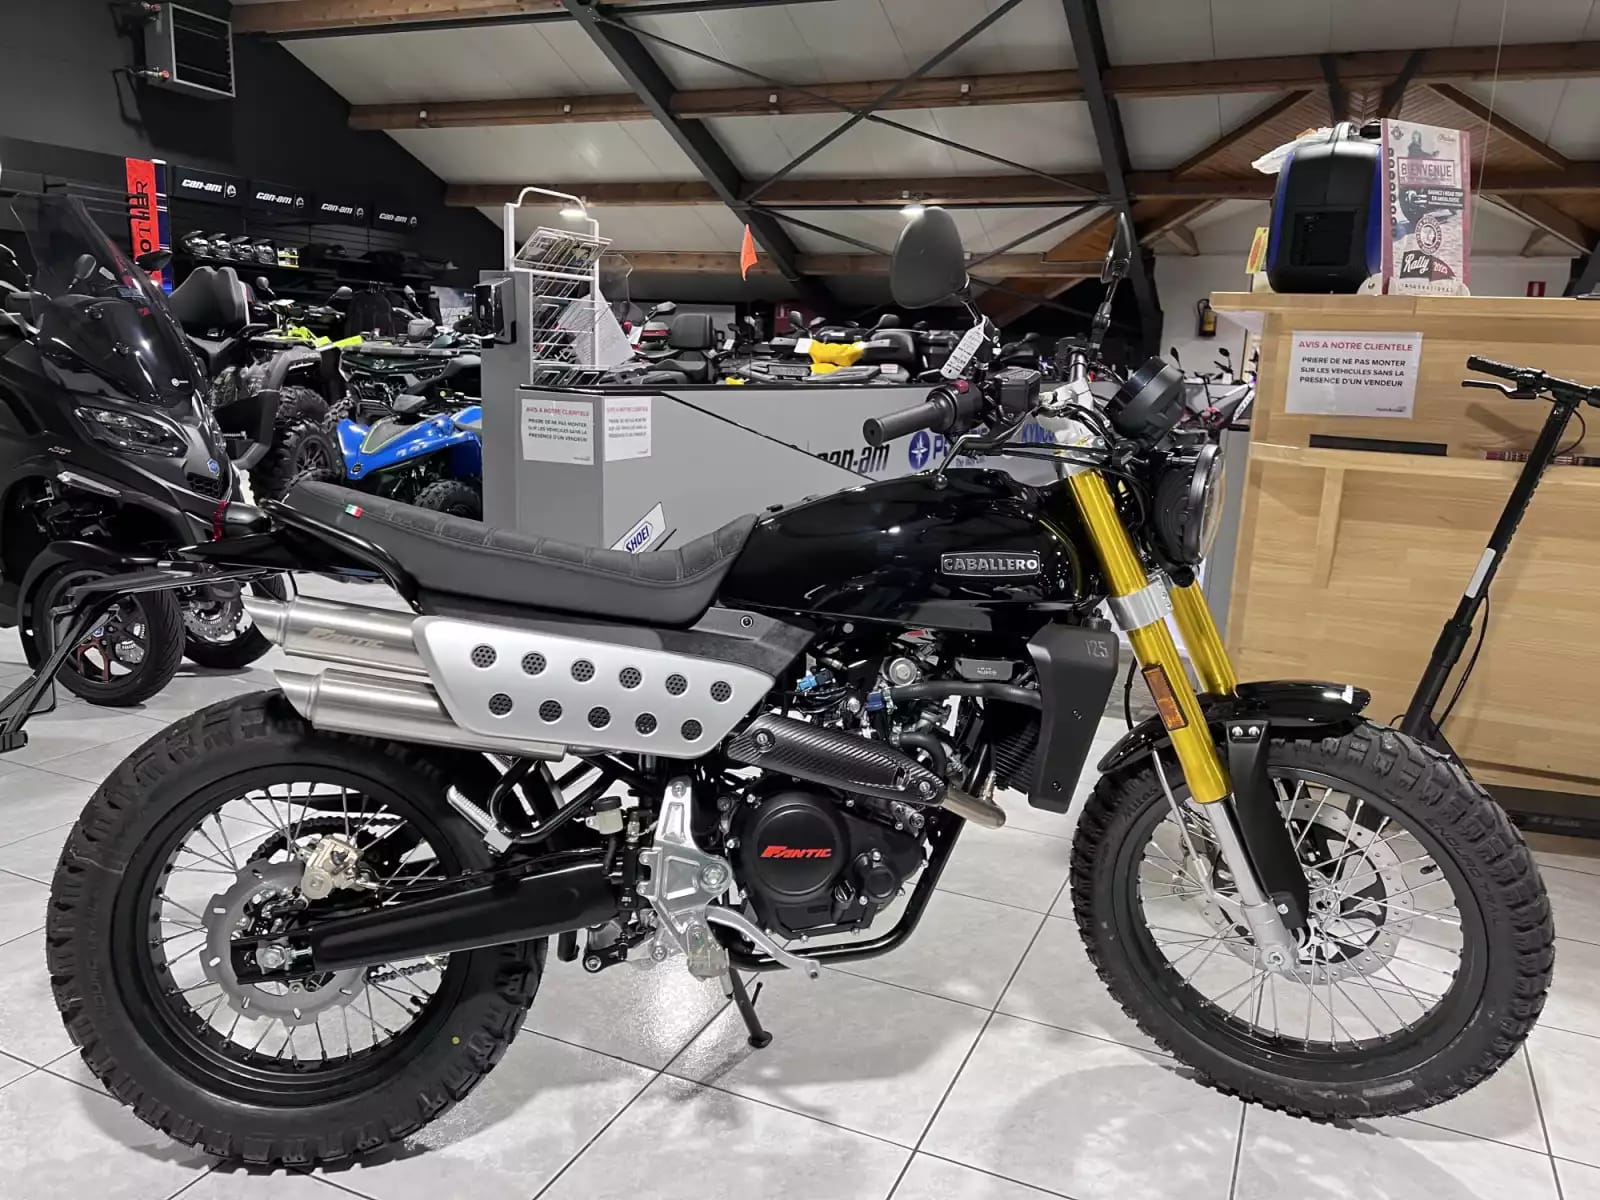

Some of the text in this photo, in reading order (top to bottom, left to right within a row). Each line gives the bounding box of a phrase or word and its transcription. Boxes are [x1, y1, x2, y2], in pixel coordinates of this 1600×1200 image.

[1401, 163, 1453, 177] BIENVENUE
[182, 179, 222, 193] can-am
[256, 191, 292, 205] can-am
[321, 203, 353, 215] can-am
[379, 212, 408, 223] can-am
[1403, 253, 1430, 275] Rally
[1299, 341, 1320, 349] AVIS
[1330, 342, 1362, 350] NOTRE
[1363, 343, 1413, 352] CLIENTELE
[1329, 357, 1340, 365] DE
[1354, 358, 1370, 366] PAS
[1371, 359, 1406, 367] MONTER
[1331, 367, 1372, 376] VEHICULES
[1373, 369, 1393, 377] SANS
[1299, 376, 1403, 387] PRESENCE D'UN VENDEUR
[625, 524, 650, 553] SHOEI
[943, 557, 1038, 571] CABALLERO
[1085, 639, 1109, 658] 125
[760, 845, 832, 858] FANTIC
